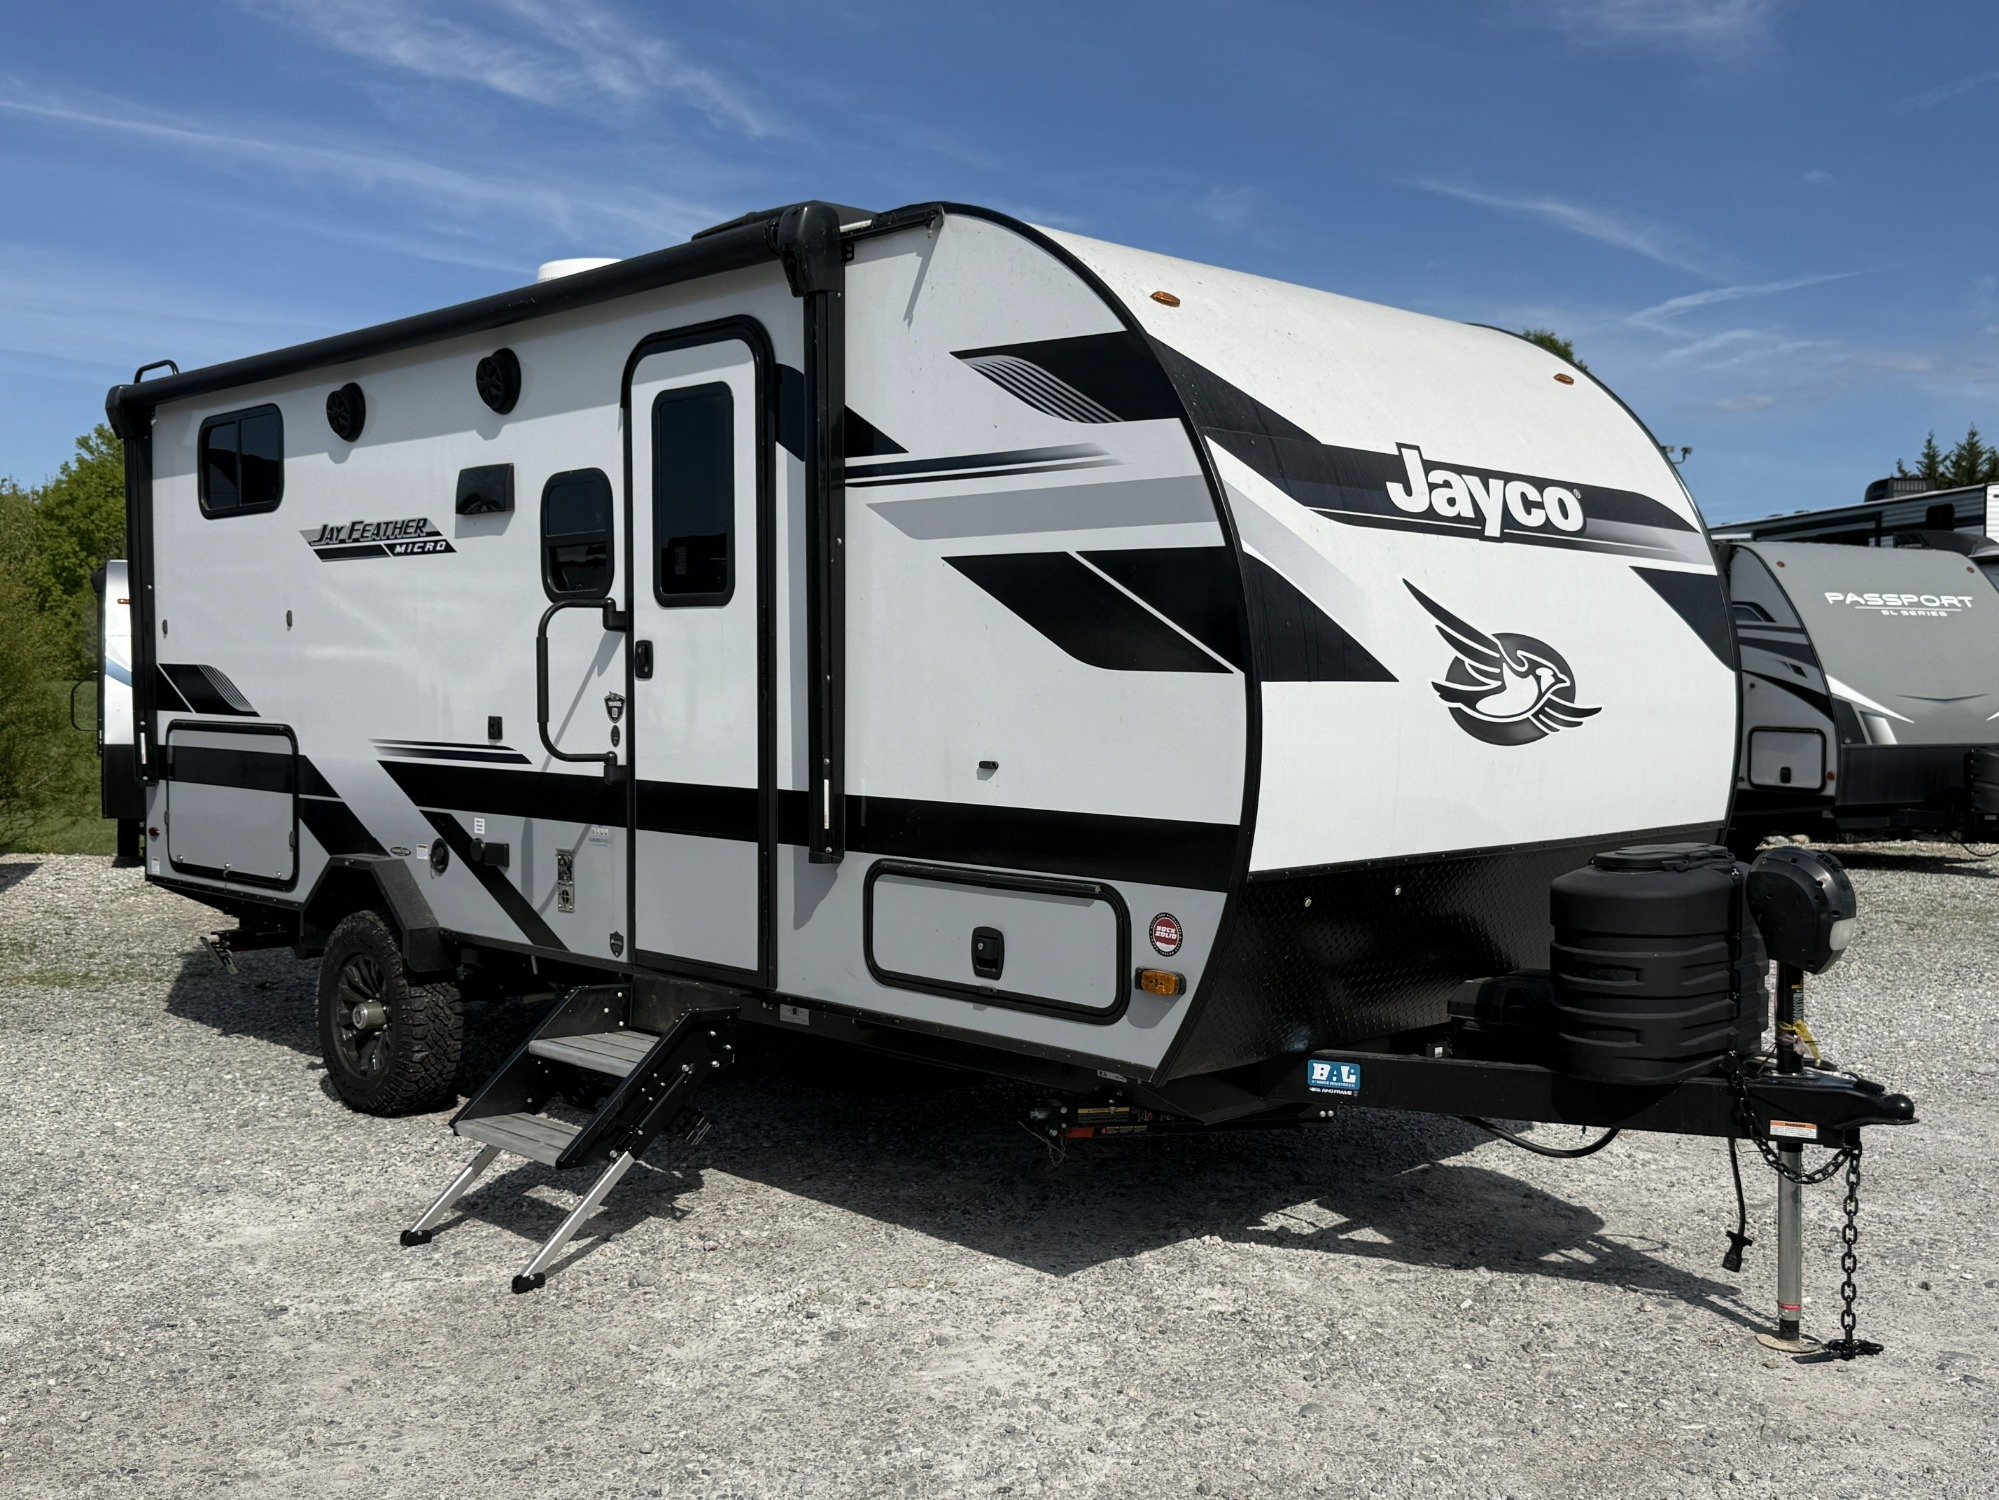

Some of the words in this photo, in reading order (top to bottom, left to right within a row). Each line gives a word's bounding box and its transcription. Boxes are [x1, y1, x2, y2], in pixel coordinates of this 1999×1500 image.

[1386, 447, 1584, 538] Jayco
[311, 524, 345, 545] JAY
[346, 517, 428, 543] FEATHER
[394, 541, 447, 553] MICRO
[1824, 592, 1973, 608] PASSPORT
[1155, 930, 1177, 940] SOLID
[1156, 925, 1176, 934] ROCK
[1312, 1063, 1357, 1083] BAL
